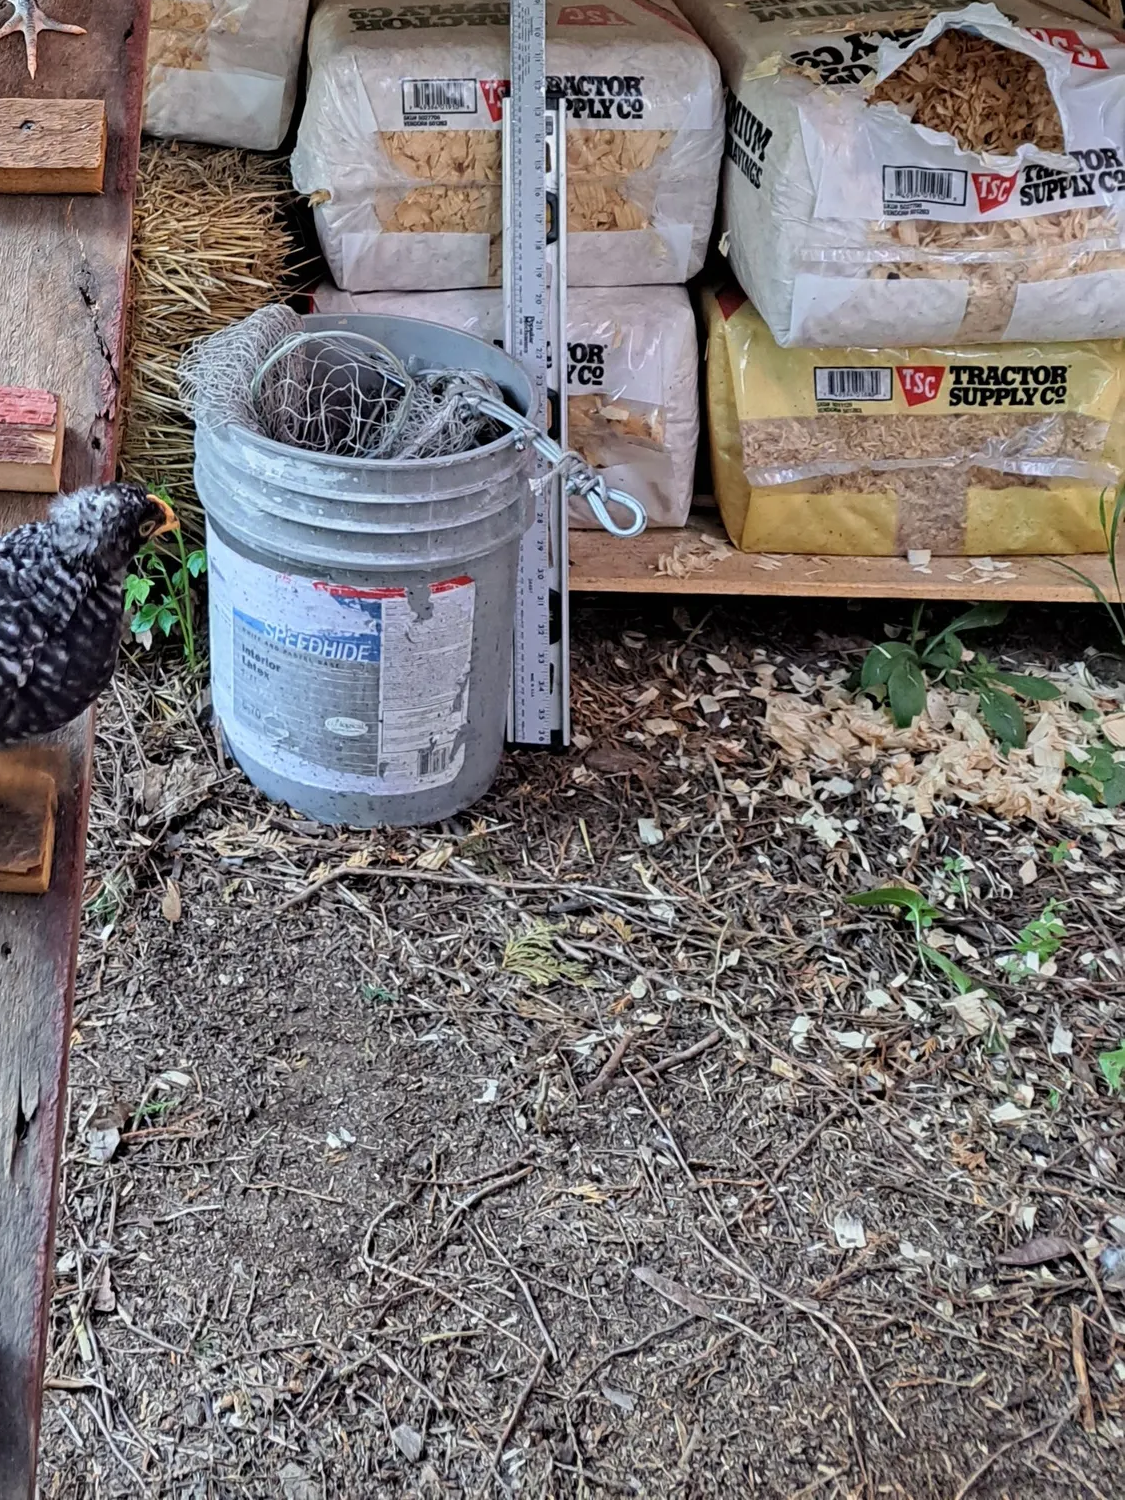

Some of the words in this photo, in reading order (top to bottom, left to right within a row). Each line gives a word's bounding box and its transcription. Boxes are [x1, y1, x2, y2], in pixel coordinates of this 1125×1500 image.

[397, 2, 510, 17] UPPLY
[352, 14, 510, 32] RACTOR
[545, 76, 643, 97] RACTOR
[978, 176, 1010, 201] TSC
[1020, 172, 1095, 206] SUPPLY
[535, 293, 542, 304] 20
[536, 348, 543, 359] 22
[949, 365, 1068, 385] TRACTOR
[902, 368, 936, 398] TSC
[949, 386, 1039, 406] SUPPLY
[536, 512, 543, 524] 28
[536, 540, 543, 552] 29
[537, 568, 544, 580] 30
[537, 595, 544, 606] 31
[538, 624, 544, 636] 32
[264, 621, 372, 663] SPEEDHIDE
[242, 643, 281, 672] Interior
[538, 652, 544, 664] 33
[538, 681, 544, 692] 34
[538, 709, 545, 720] 35
[538, 730, 545, 741] 36
